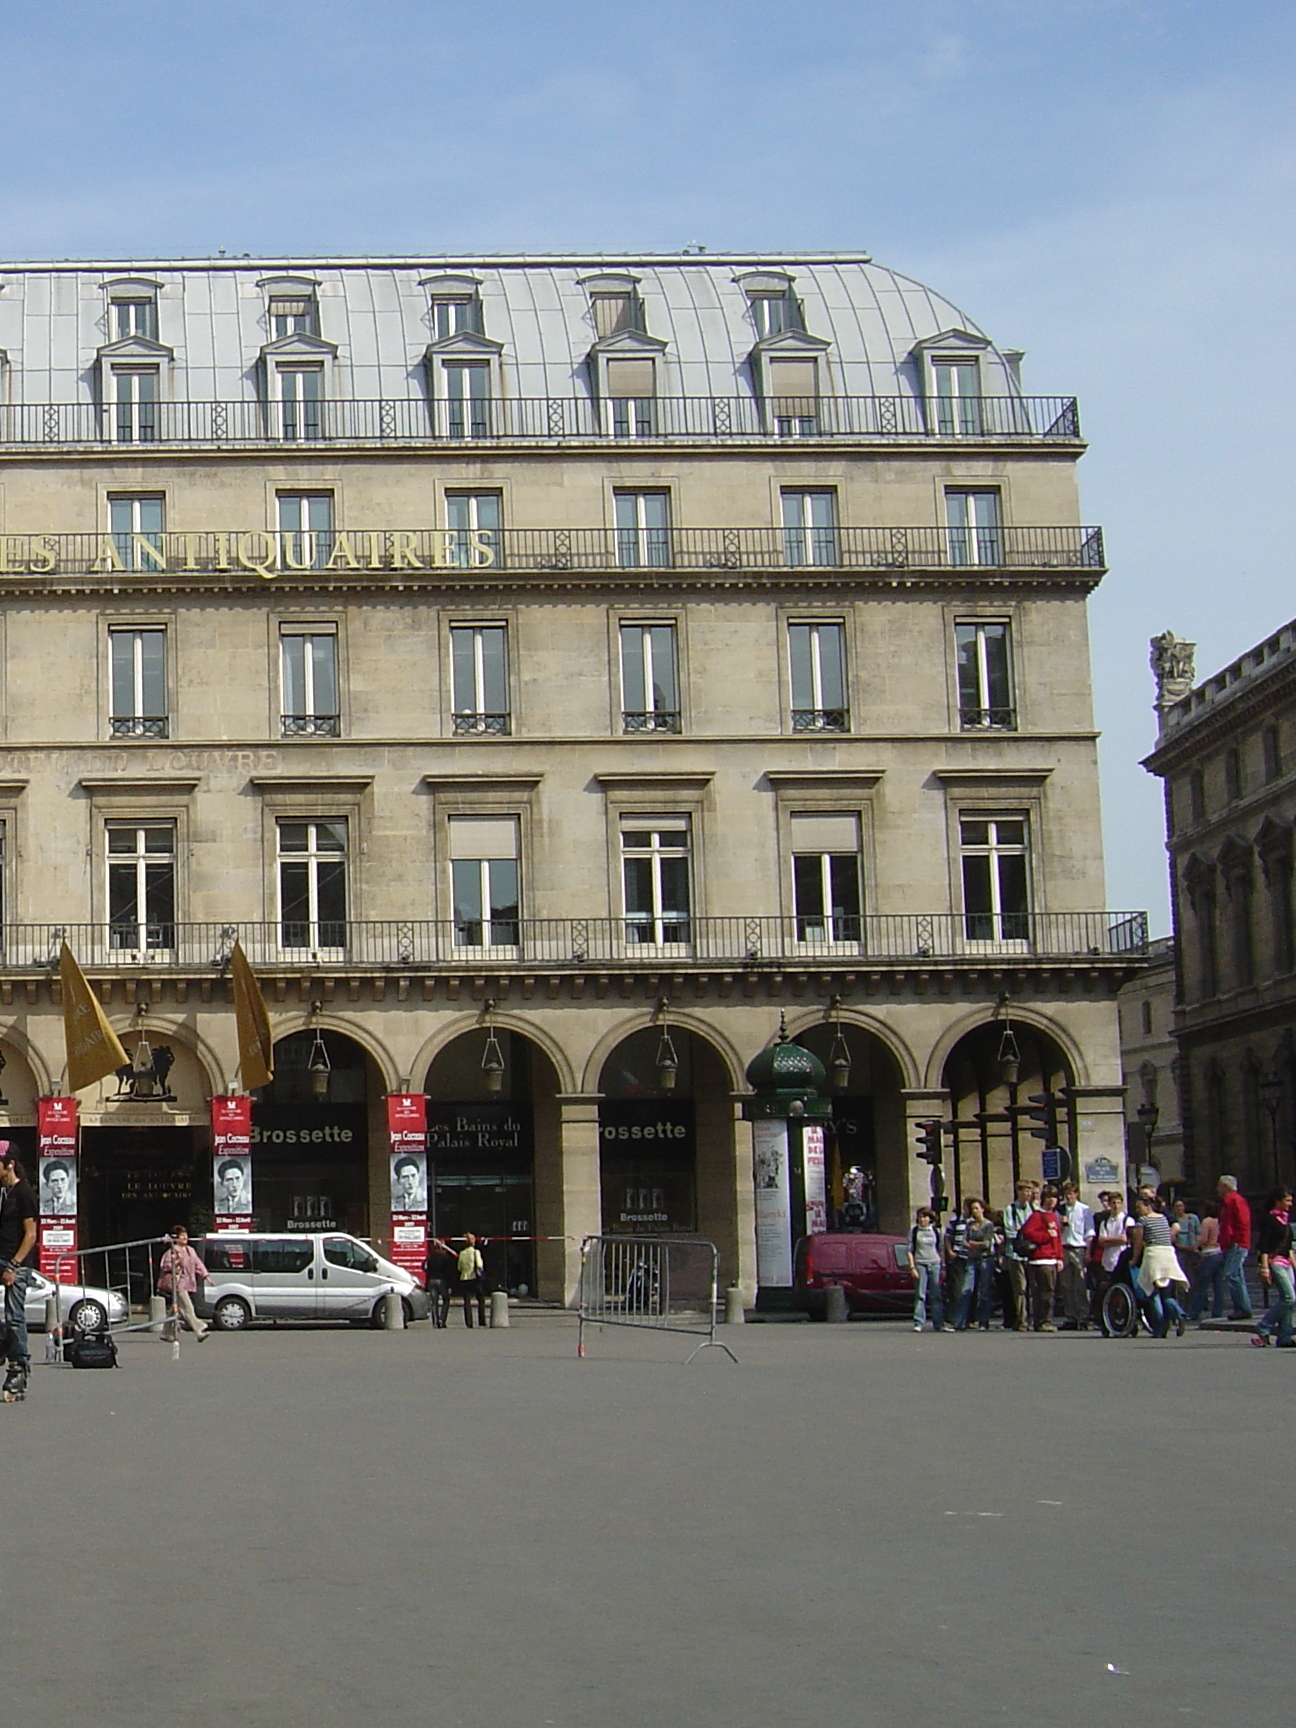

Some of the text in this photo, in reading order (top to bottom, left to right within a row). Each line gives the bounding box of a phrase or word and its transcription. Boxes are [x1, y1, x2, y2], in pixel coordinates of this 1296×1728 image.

[91, 530, 496, 578] ANTIQUAIRES
[86, 751, 128, 772] DU
[146, 751, 277, 772] LOUVRE
[456, 1116, 497, 1131] Bains
[504, 1116, 521, 1131] du
[250, 1124, 353, 1143] Brossette
[426, 1131, 518, 1150] Palais Royal
[287, 1220, 337, 1229] Brossette
[620, 1213, 668, 1222] Brossette
